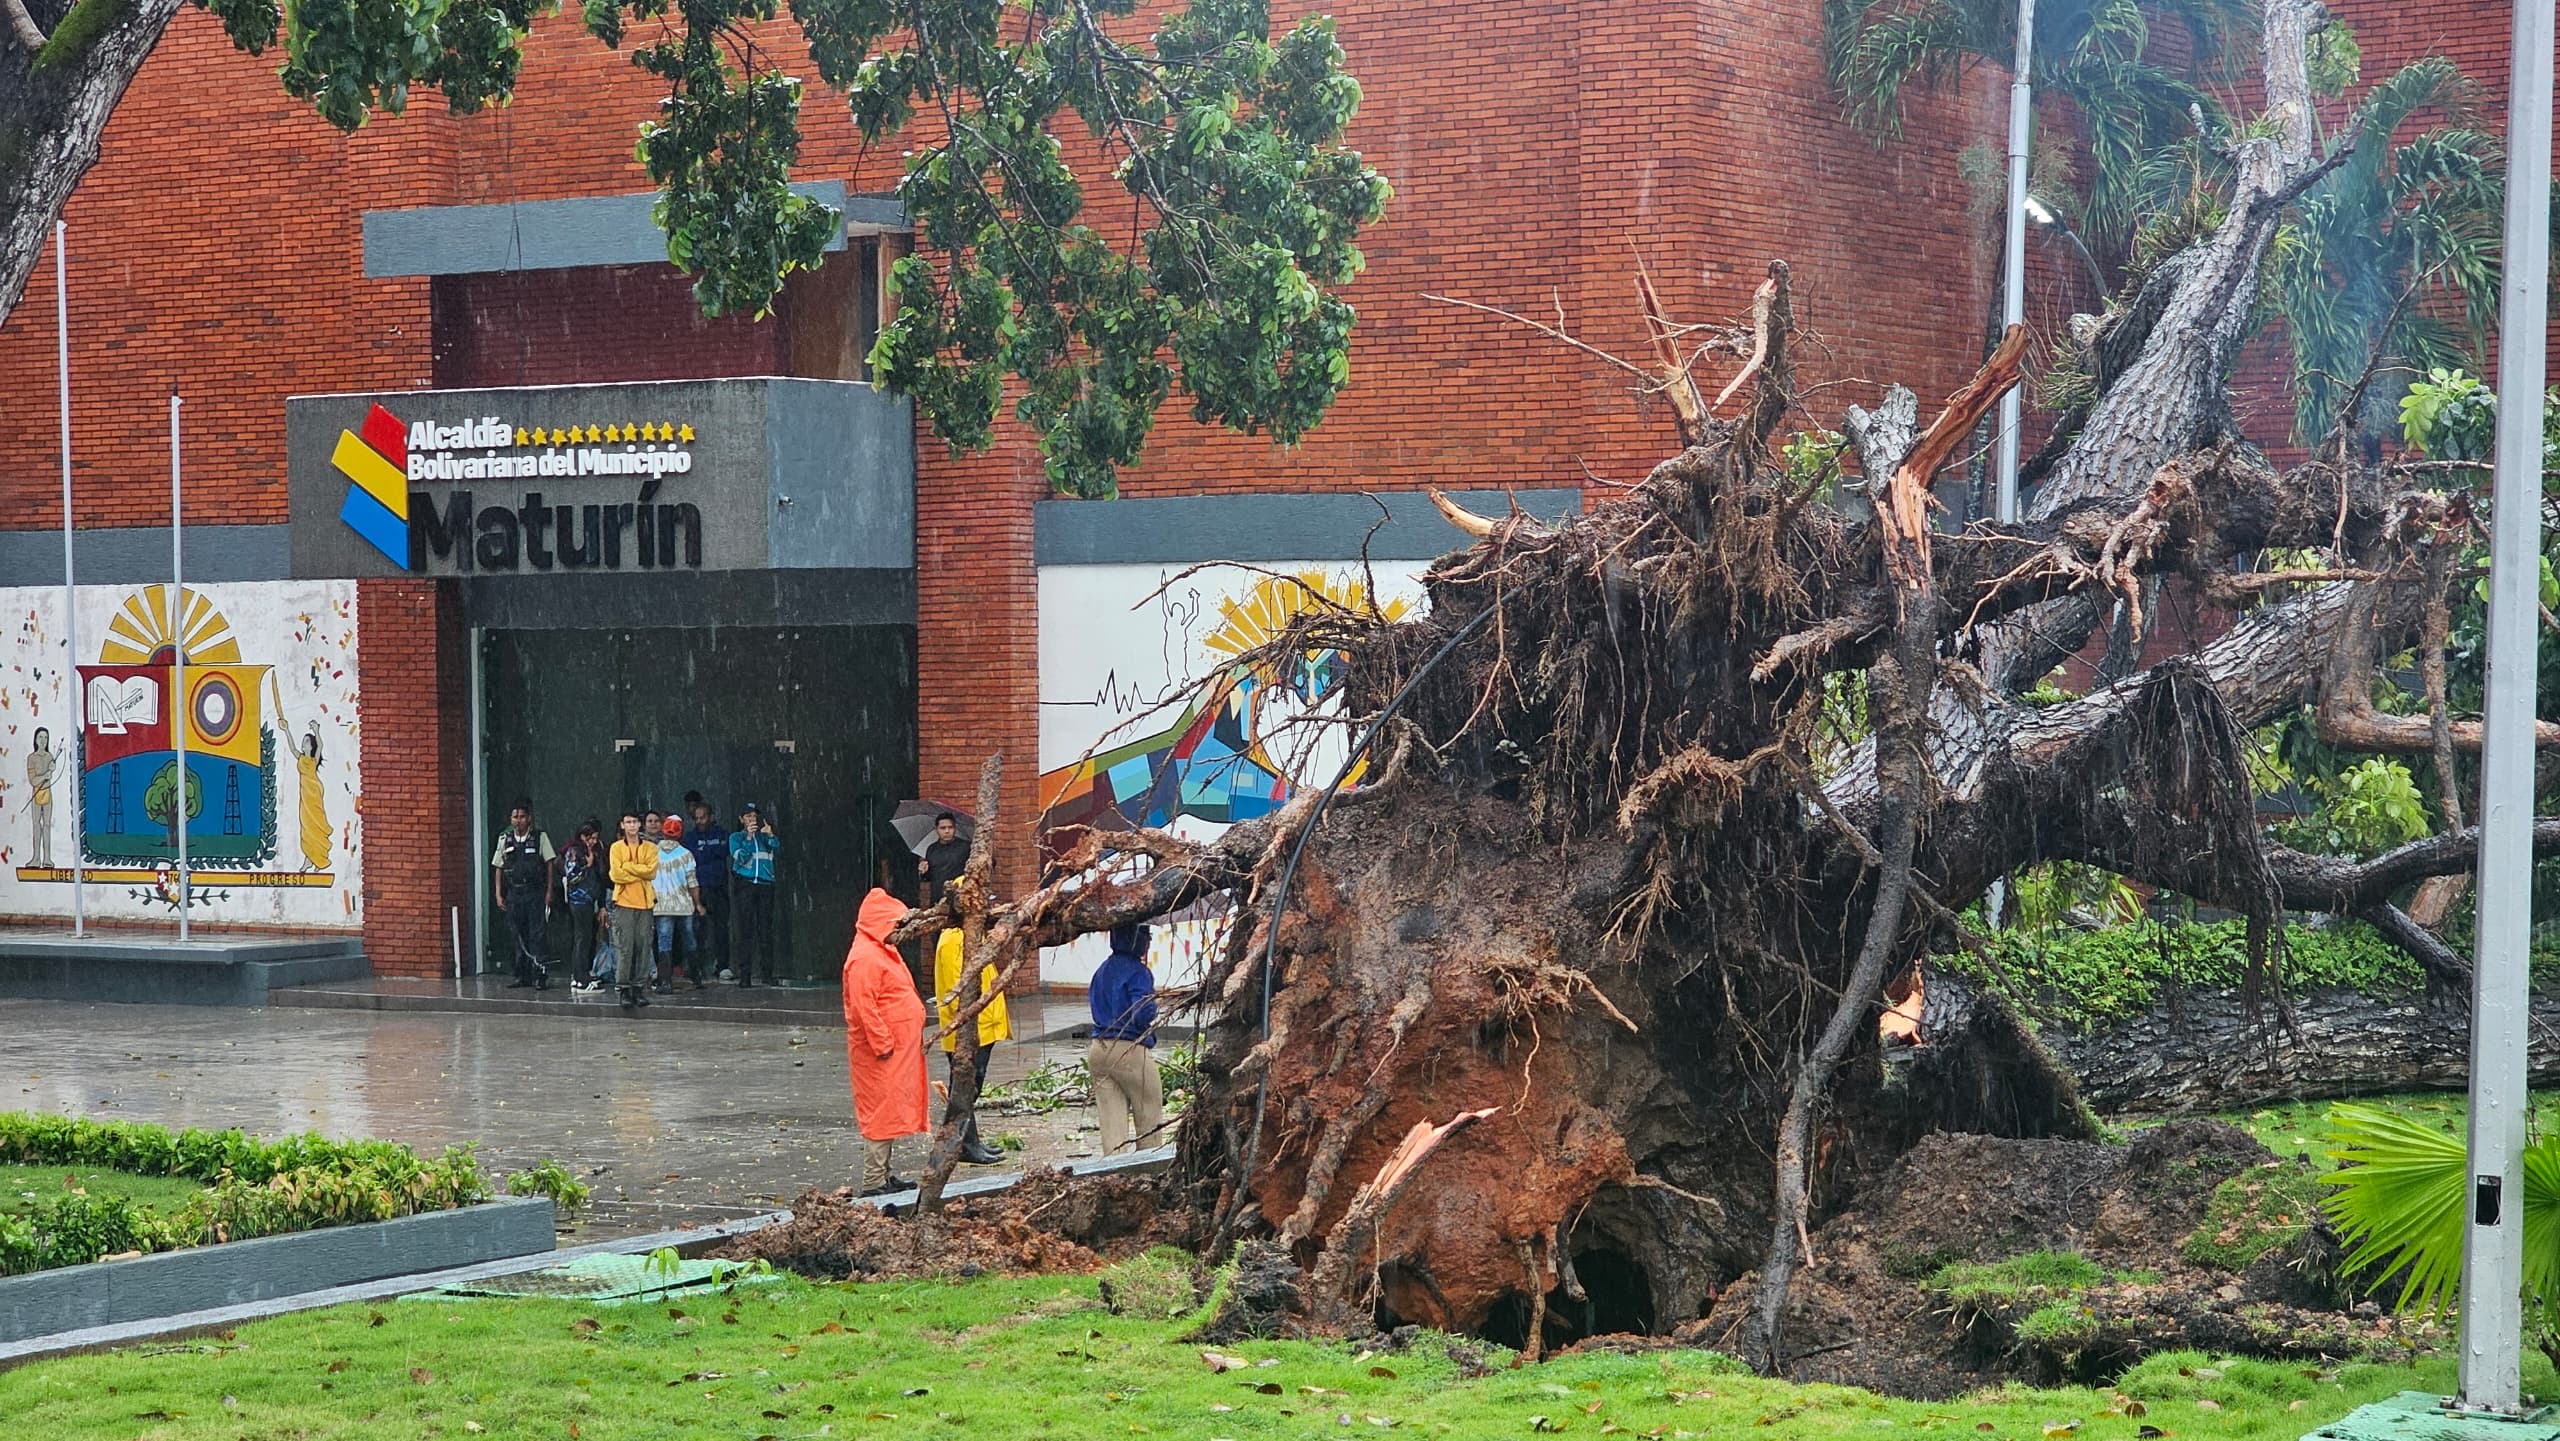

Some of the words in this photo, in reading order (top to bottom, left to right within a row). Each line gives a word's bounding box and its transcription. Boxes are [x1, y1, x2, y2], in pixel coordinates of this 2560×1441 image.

[408, 417, 512, 450] Alcaldía
[407, 450, 538, 480] Bolivariana
[539, 448, 577, 476] del
[578, 444, 691, 479] Municipio
[408, 480, 701, 571] Maturín
[50, 870, 94, 881] LIBERAD
[249, 873, 305, 885] PROGRESO
